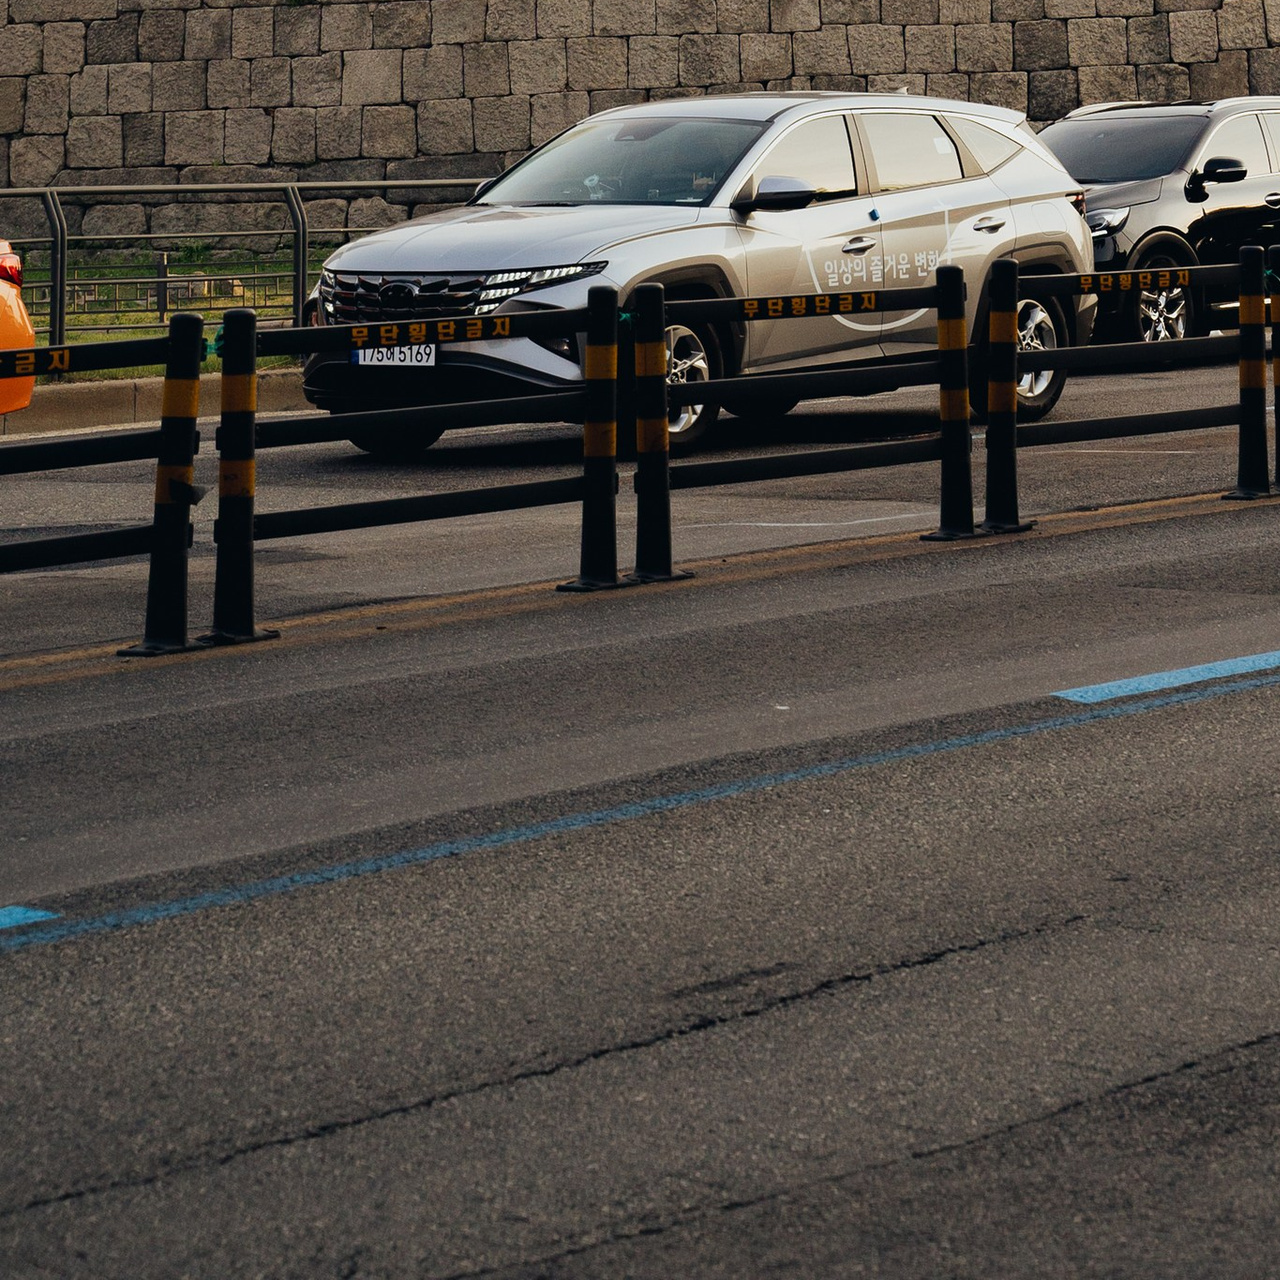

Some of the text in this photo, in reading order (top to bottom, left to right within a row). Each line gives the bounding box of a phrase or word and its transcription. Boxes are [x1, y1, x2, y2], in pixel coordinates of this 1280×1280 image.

[824, 249, 941, 287] 일상의 즐거운 변화
[1081, 270, 1189, 292] 무단횡단금지
[744, 293, 876, 318] 무단횡단금지
[352, 317, 511, 347] 무단횡단금지
[0, 349, 70, 374] 금지
[399, 344, 432, 363] 5169
